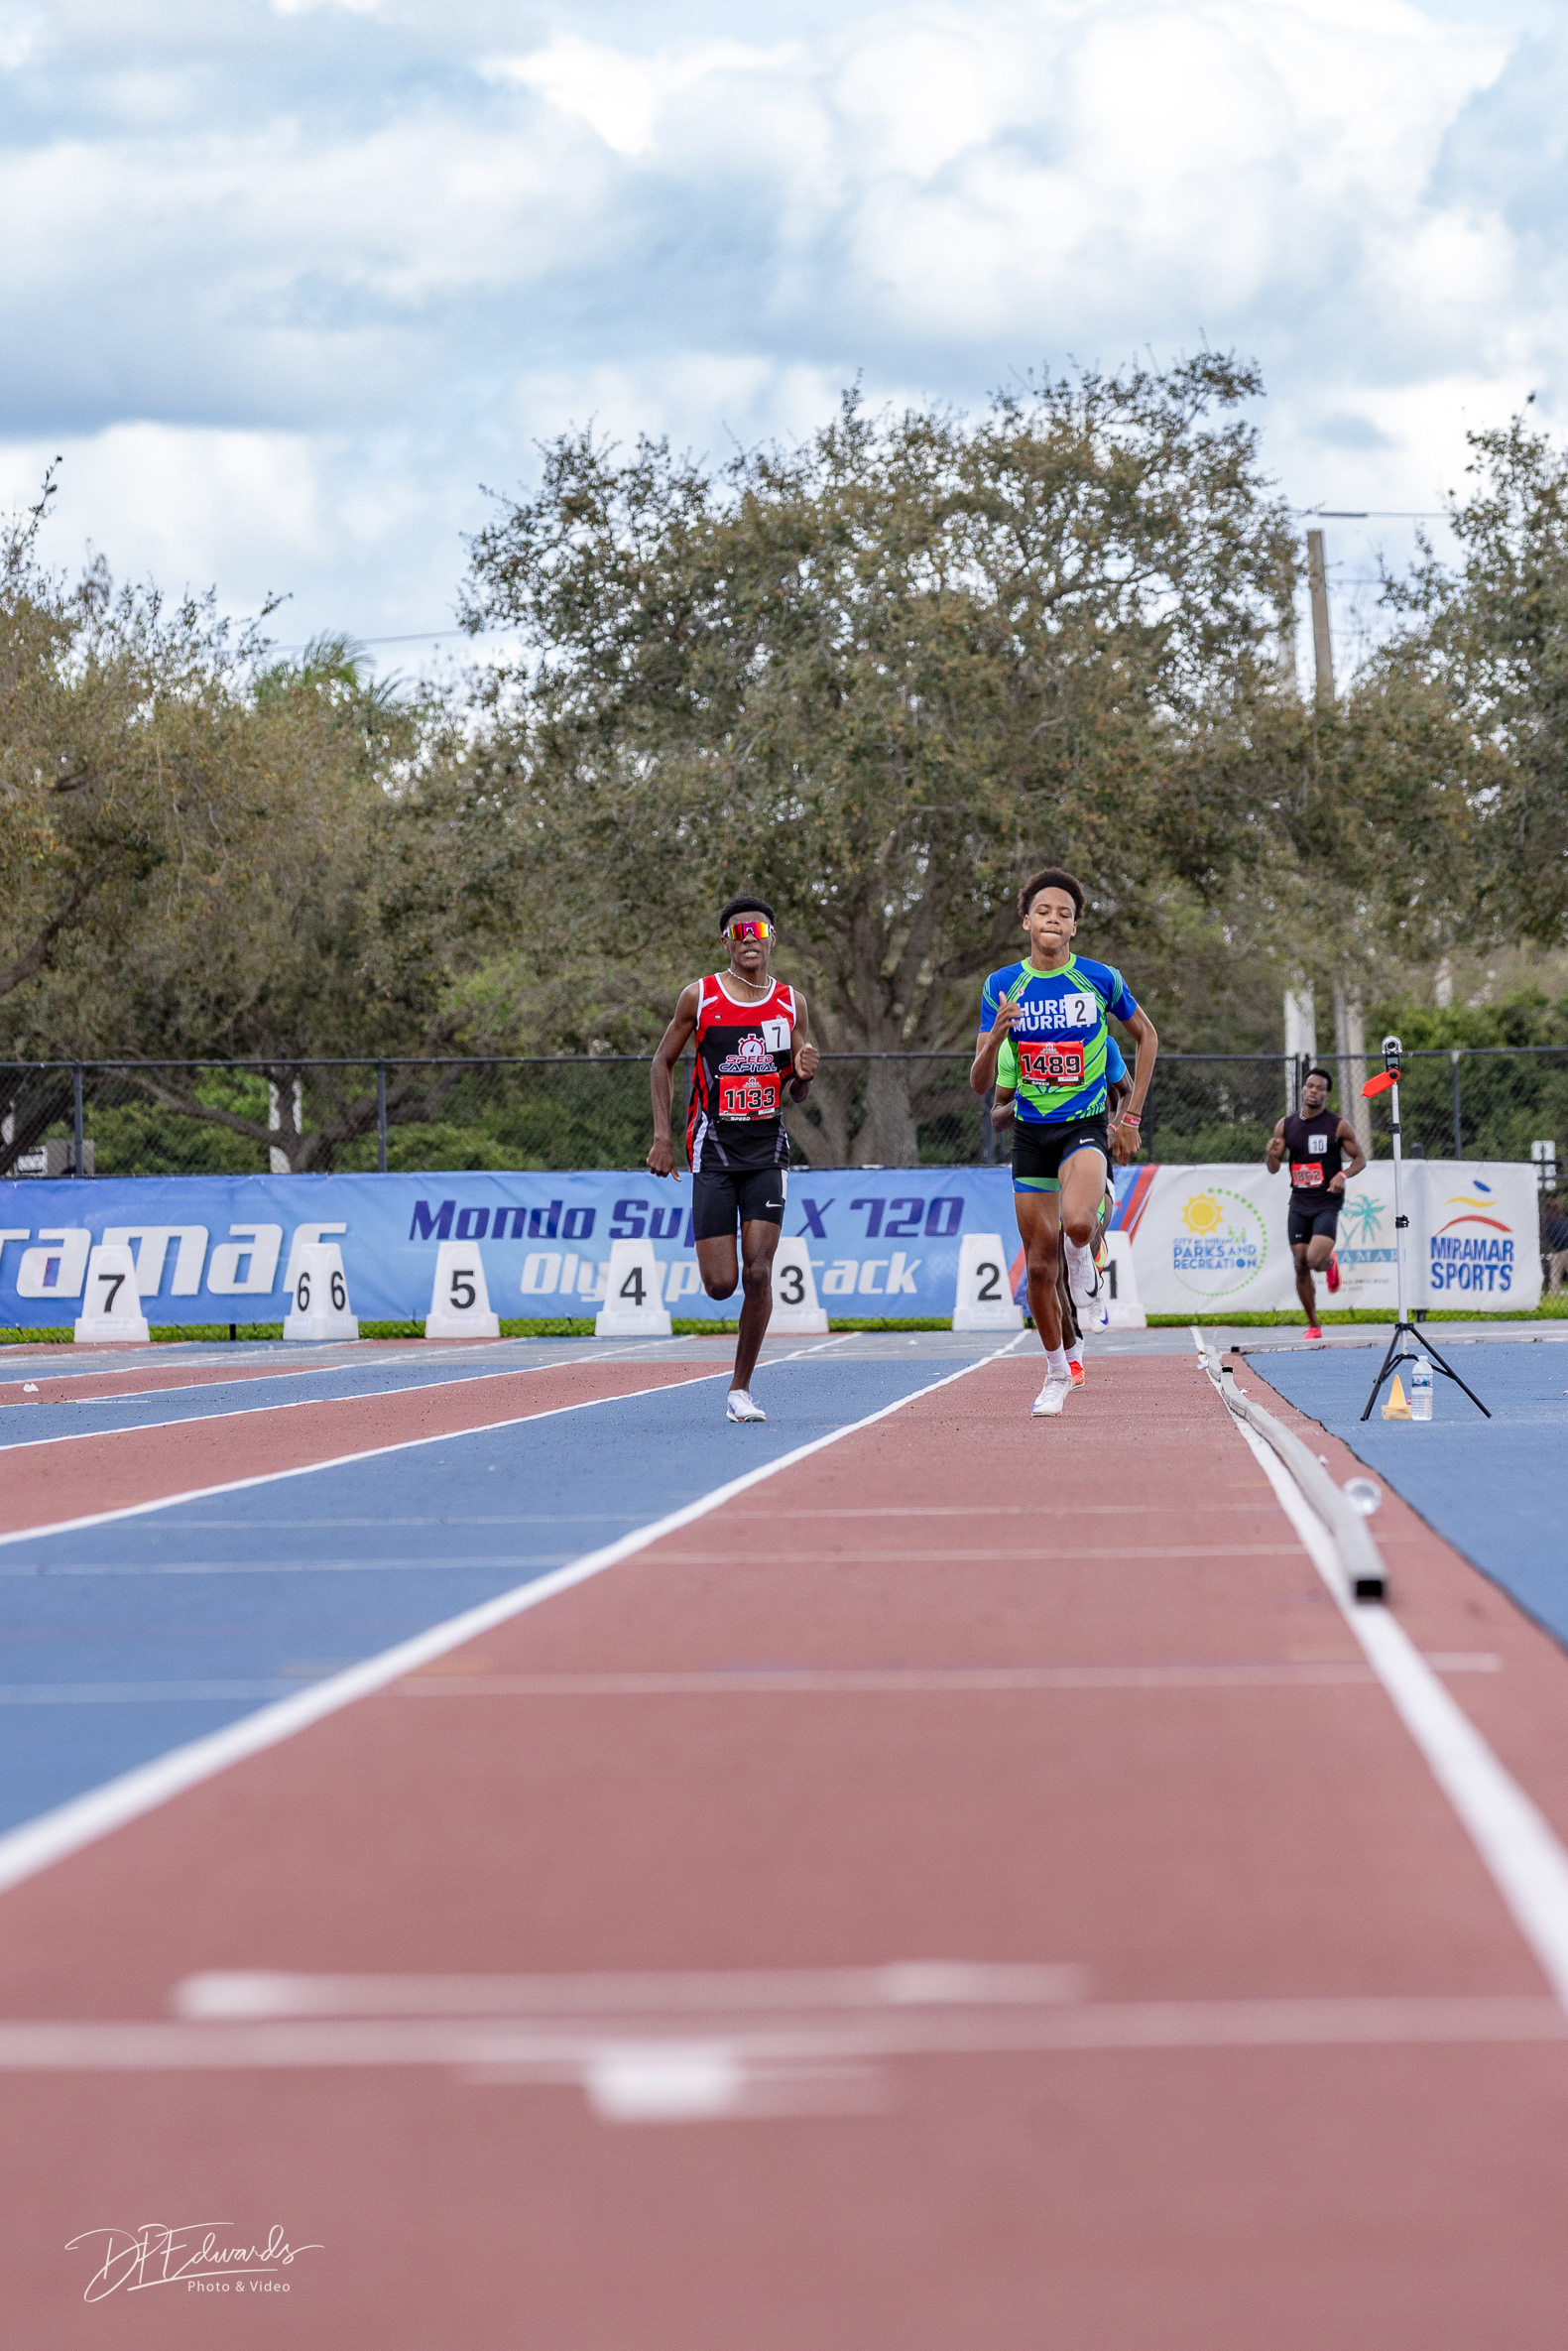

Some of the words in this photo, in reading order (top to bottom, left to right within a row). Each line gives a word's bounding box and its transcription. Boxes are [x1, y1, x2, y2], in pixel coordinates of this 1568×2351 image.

[1012, 1014, 1092, 1033] MURR
[1074, 999, 1087, 1023] 2
[771, 1026, 782, 1049] 7
[719, 1062, 778, 1073] CAPITAL
[726, 1054, 775, 1063] SPEED
[1021, 1053, 1082, 1075] 1489
[724, 1086, 776, 1110] 1133
[1312, 1139, 1325, 1153] 10
[409, 1199, 596, 1240] Mondo
[795, 1197, 836, 1238] X
[850, 1195, 965, 1238] 720
[1173, 1245, 1225, 1259] PARKS
[1228, 1244, 1257, 1256] AND
[1430, 1236, 1514, 1262] MIRAMAR
[1173, 1257, 1258, 1270] RECREATION
[1430, 1261, 1513, 1292] SPORTS
[298, 1272, 311, 1312] 6
[330, 1271, 346, 1311] 6
[449, 1270, 477, 1309] 5
[620, 1267, 647, 1306] 4
[780, 1265, 805, 1305] 3
[976, 1262, 1003, 1301] 2
[1102, 1259, 1118, 1300] 1
[97, 1274, 126, 1314] 7
